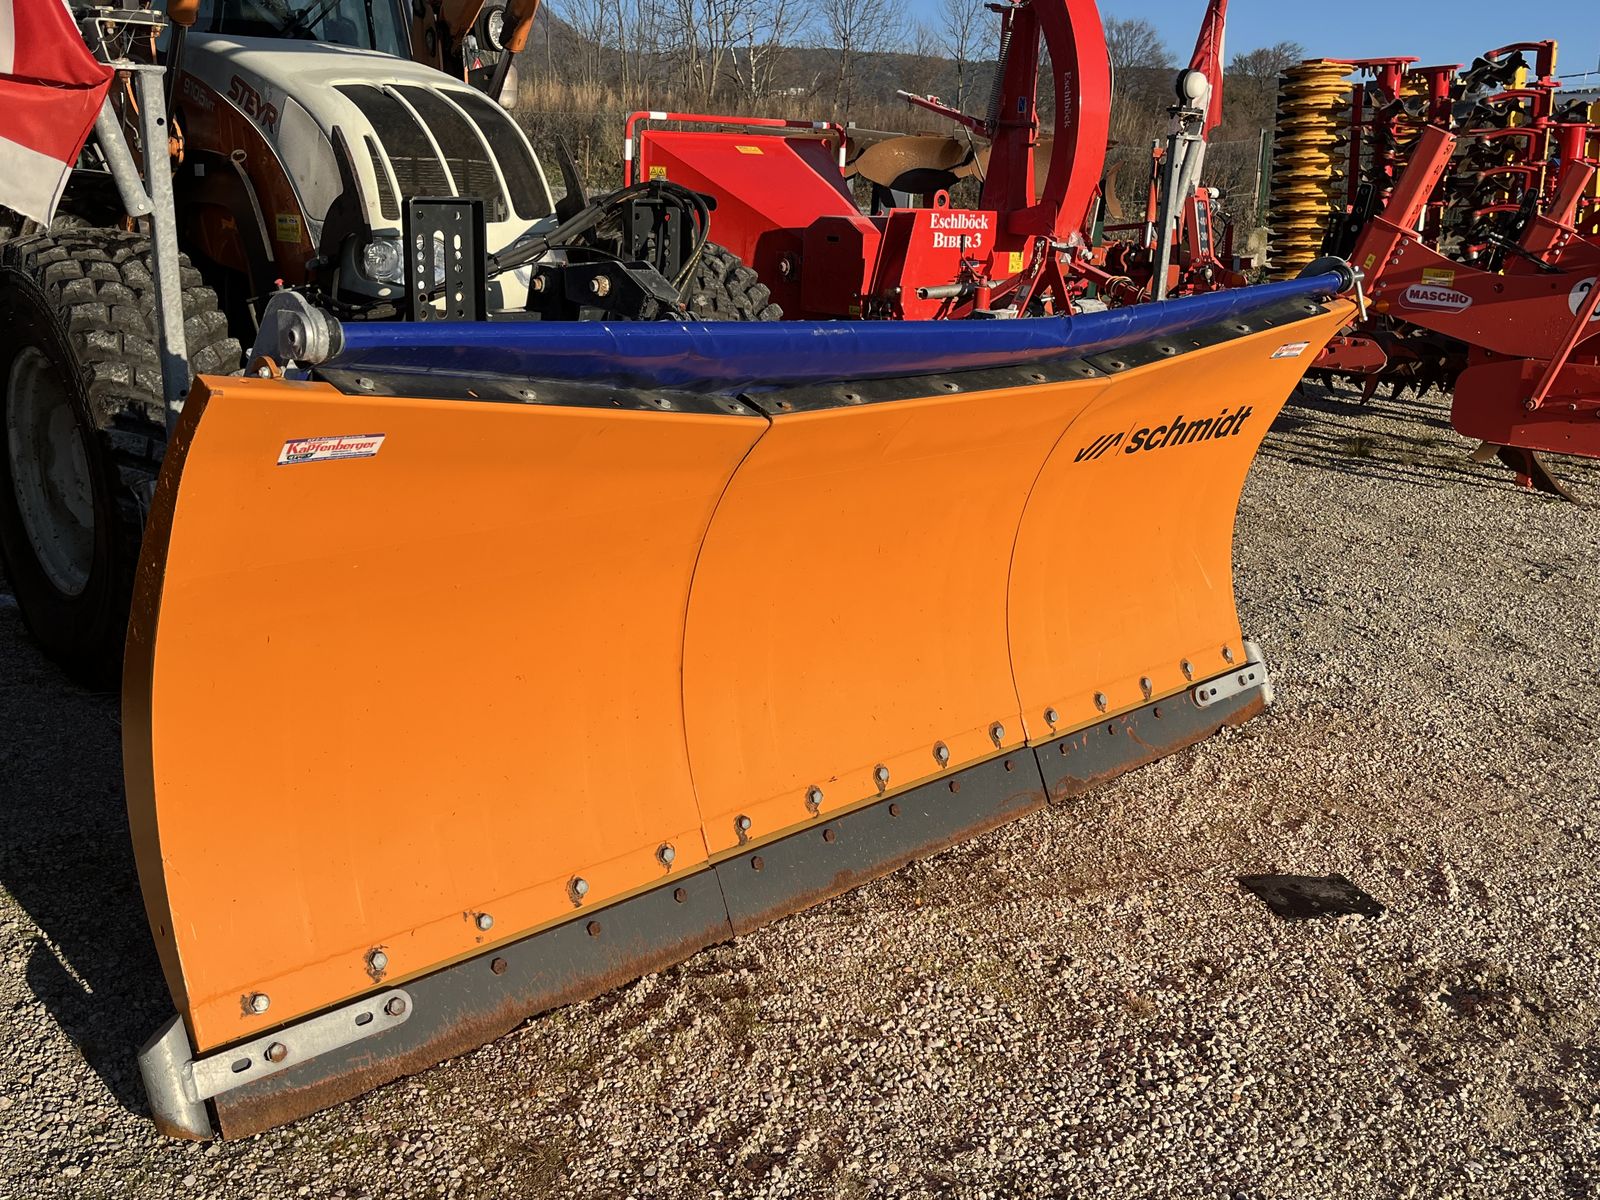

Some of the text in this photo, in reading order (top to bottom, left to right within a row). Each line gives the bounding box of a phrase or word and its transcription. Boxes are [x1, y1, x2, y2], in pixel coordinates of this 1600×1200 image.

[227, 74, 279, 134] STEYR
[930, 213, 988, 229] Eschlböck
[972, 232, 982, 248] 3
[1409, 289, 1469, 304] MASCHIO
[1125, 406, 1253, 454] schmidt
[286, 439, 377, 455] Kapfenberger
